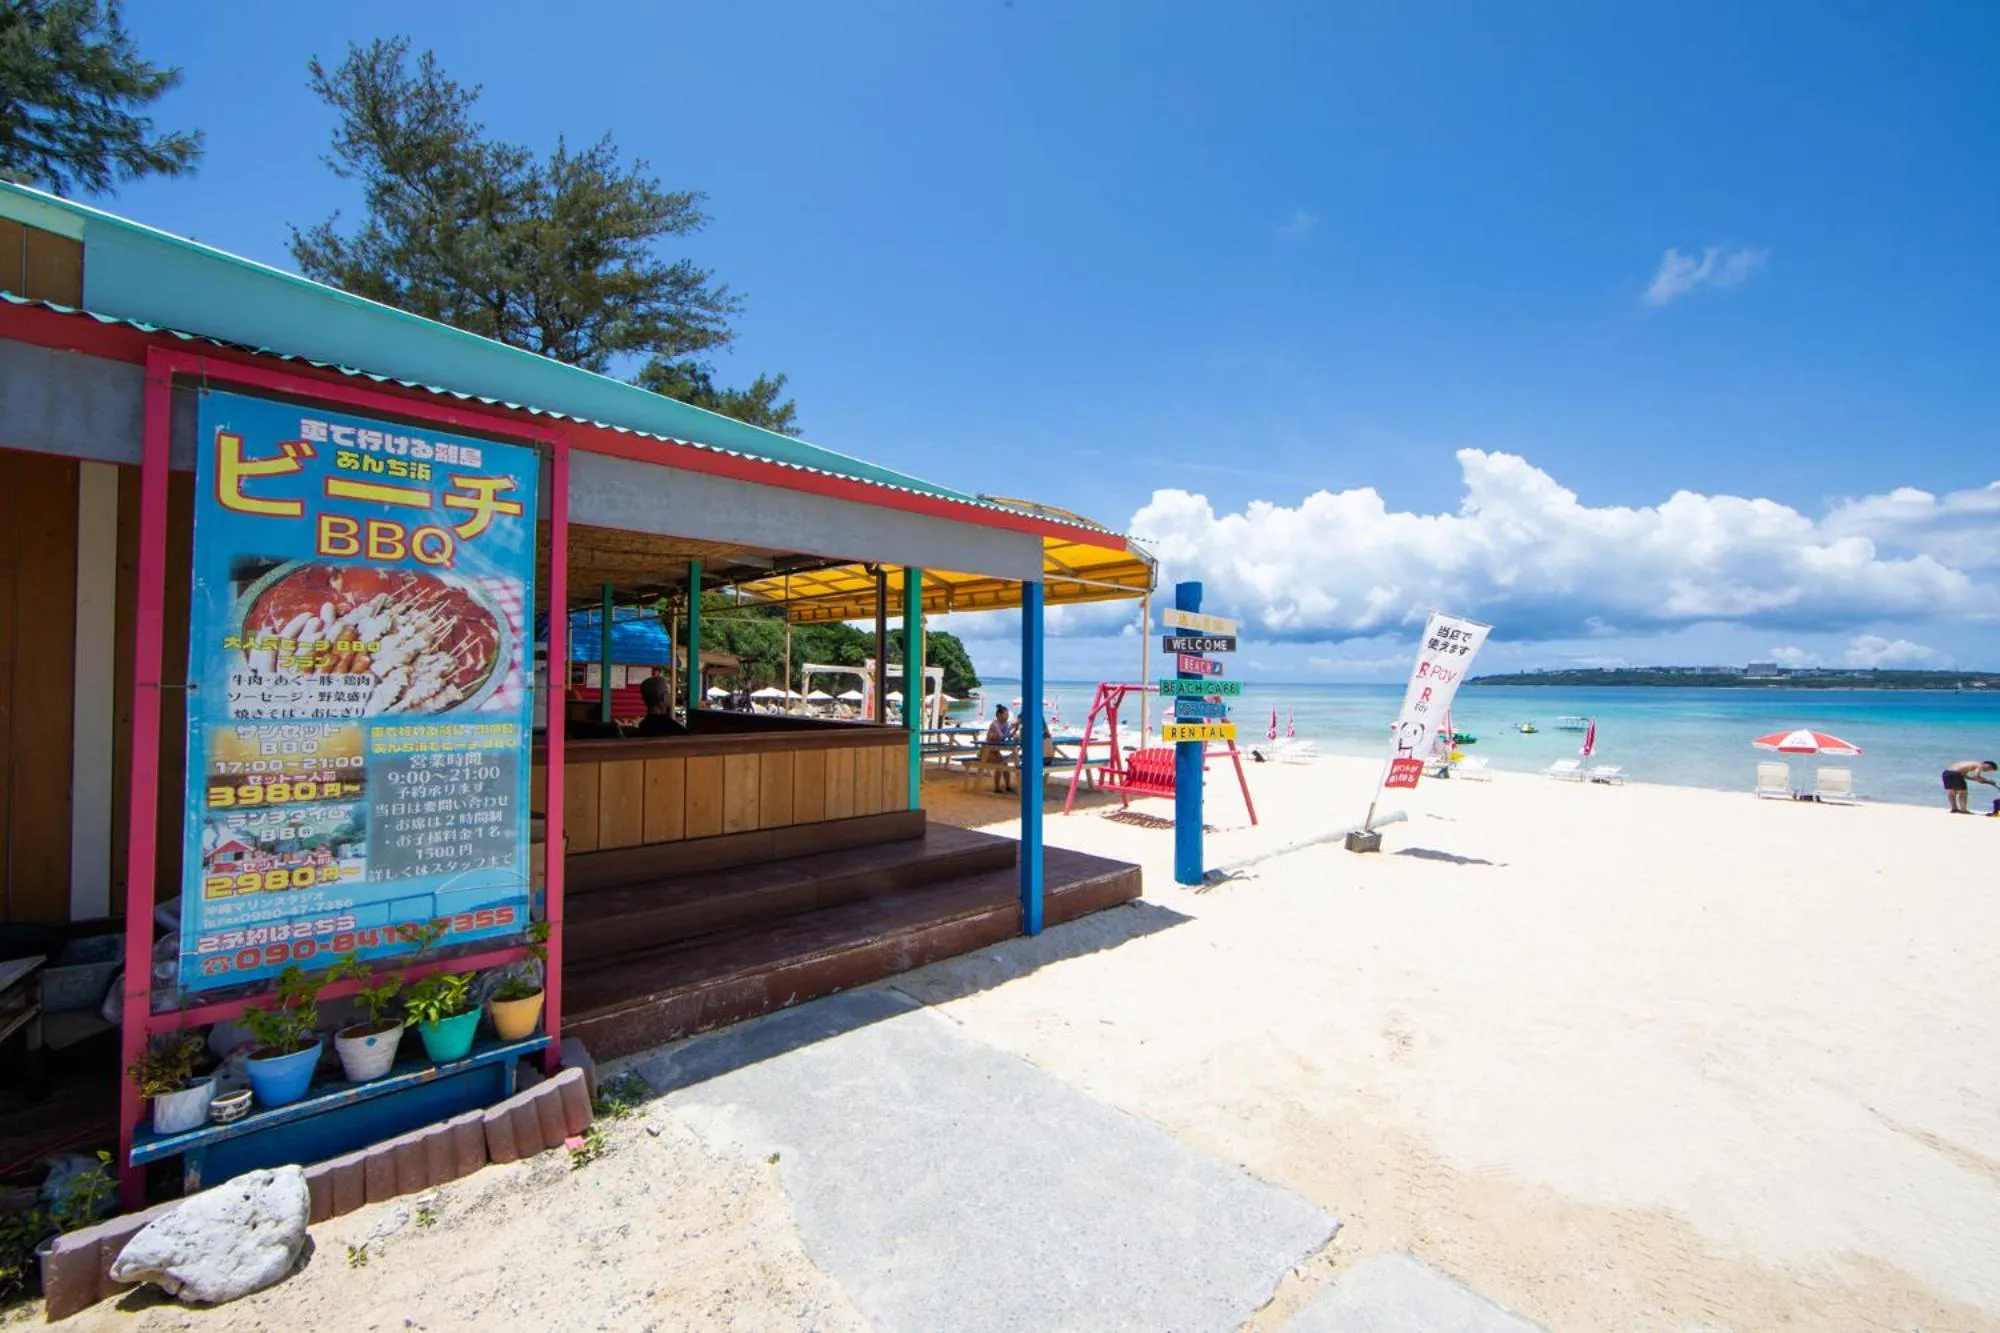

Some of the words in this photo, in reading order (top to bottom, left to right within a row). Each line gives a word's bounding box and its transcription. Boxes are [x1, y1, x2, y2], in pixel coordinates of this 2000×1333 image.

[214, 432, 524, 541] ビーチ
[316, 514, 456, 568] BBQ
[1436, 624, 1473, 645] 当店で
[1171, 639, 1228, 651] WELCOME
[1427, 638, 1471, 657] 使えます
[1183, 657, 1213, 674] BEACH
[1163, 682, 1203, 695] BEACH
[1207, 682, 1236, 695] CAFE
[236, 723, 341, 740] サンセット
[1170, 727, 1226, 739] RENTAL
[260, 740, 320, 755] BBQ
[408, 752, 483, 769] 営業時間
[395, 782, 485, 801] 予約承ります
[260, 826, 315, 842] BBQ
[197, 915, 356, 954] ご予約はこちら
